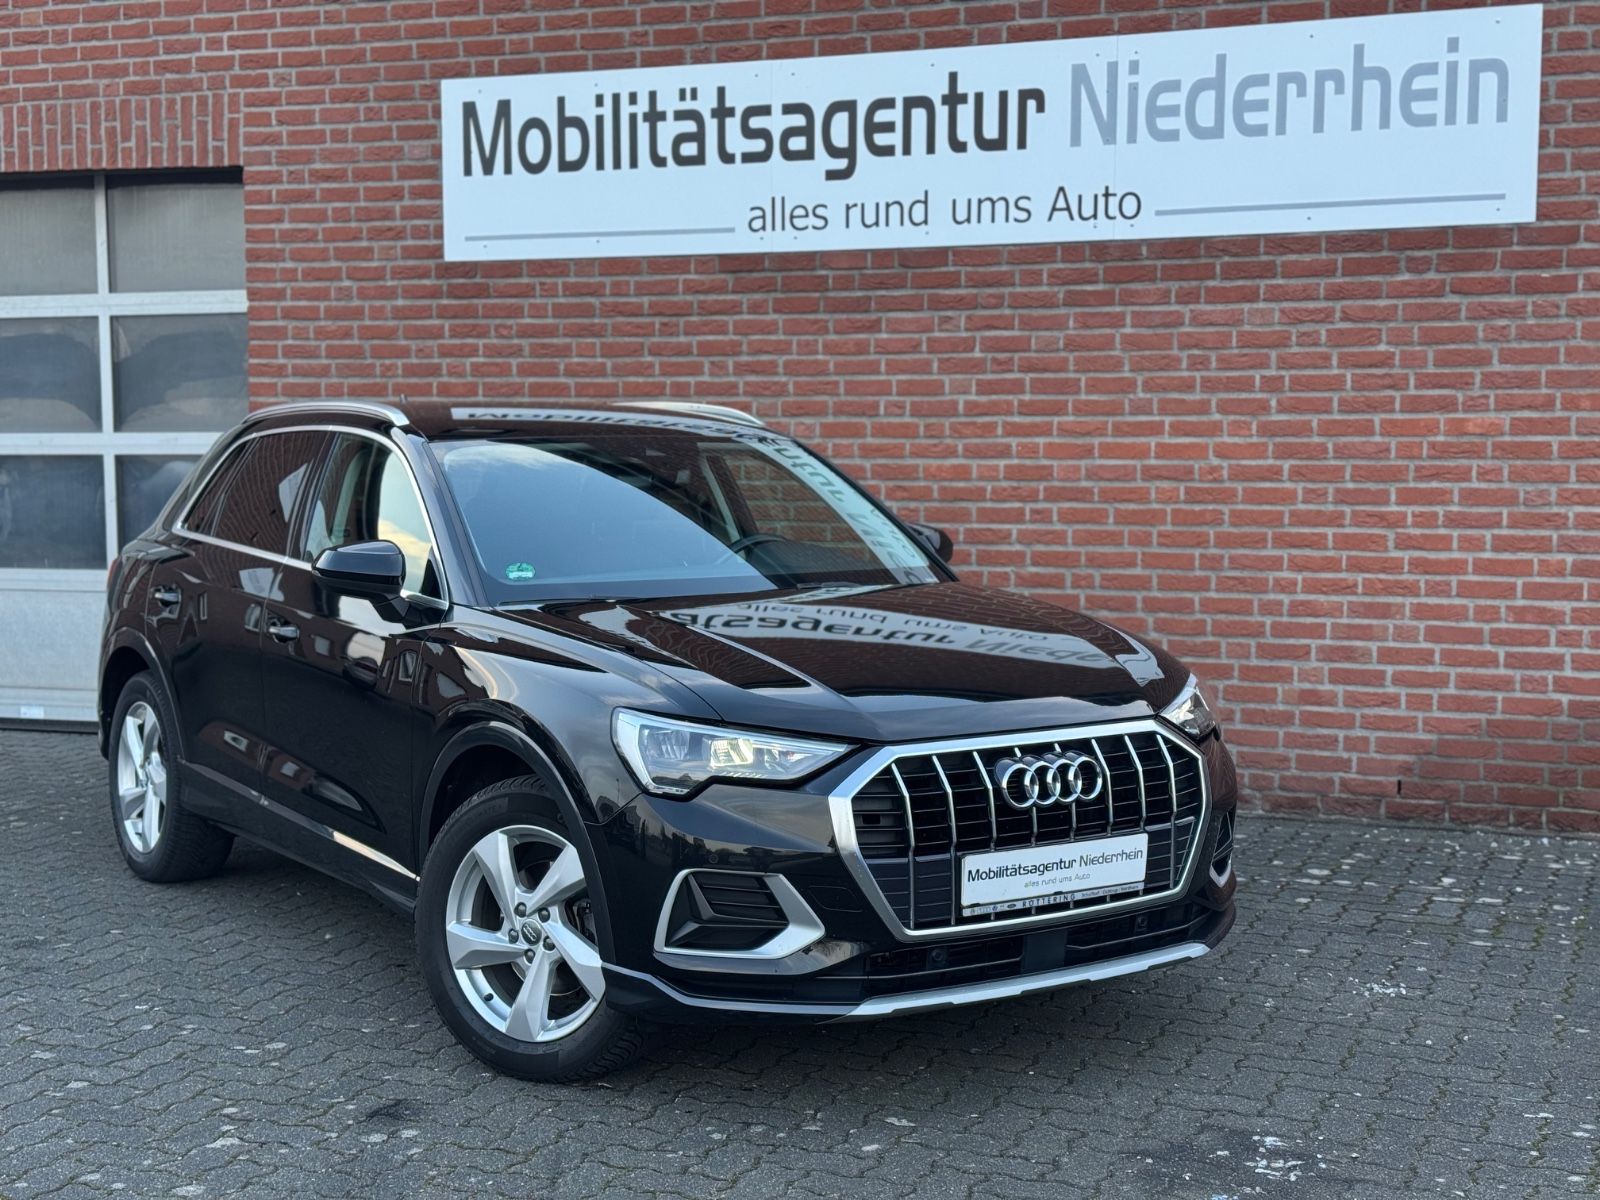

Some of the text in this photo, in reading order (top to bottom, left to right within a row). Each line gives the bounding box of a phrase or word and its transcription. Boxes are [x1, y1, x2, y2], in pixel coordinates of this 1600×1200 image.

[462, 37, 1510, 181] Mobilitätsagentur Niederrhein
[748, 185, 1142, 233] alles rund ums Auto
[967, 847, 1143, 883] Mobilitätsagentur Niederrhein
[1024, 872, 1091, 888] alles rund ums Auto
